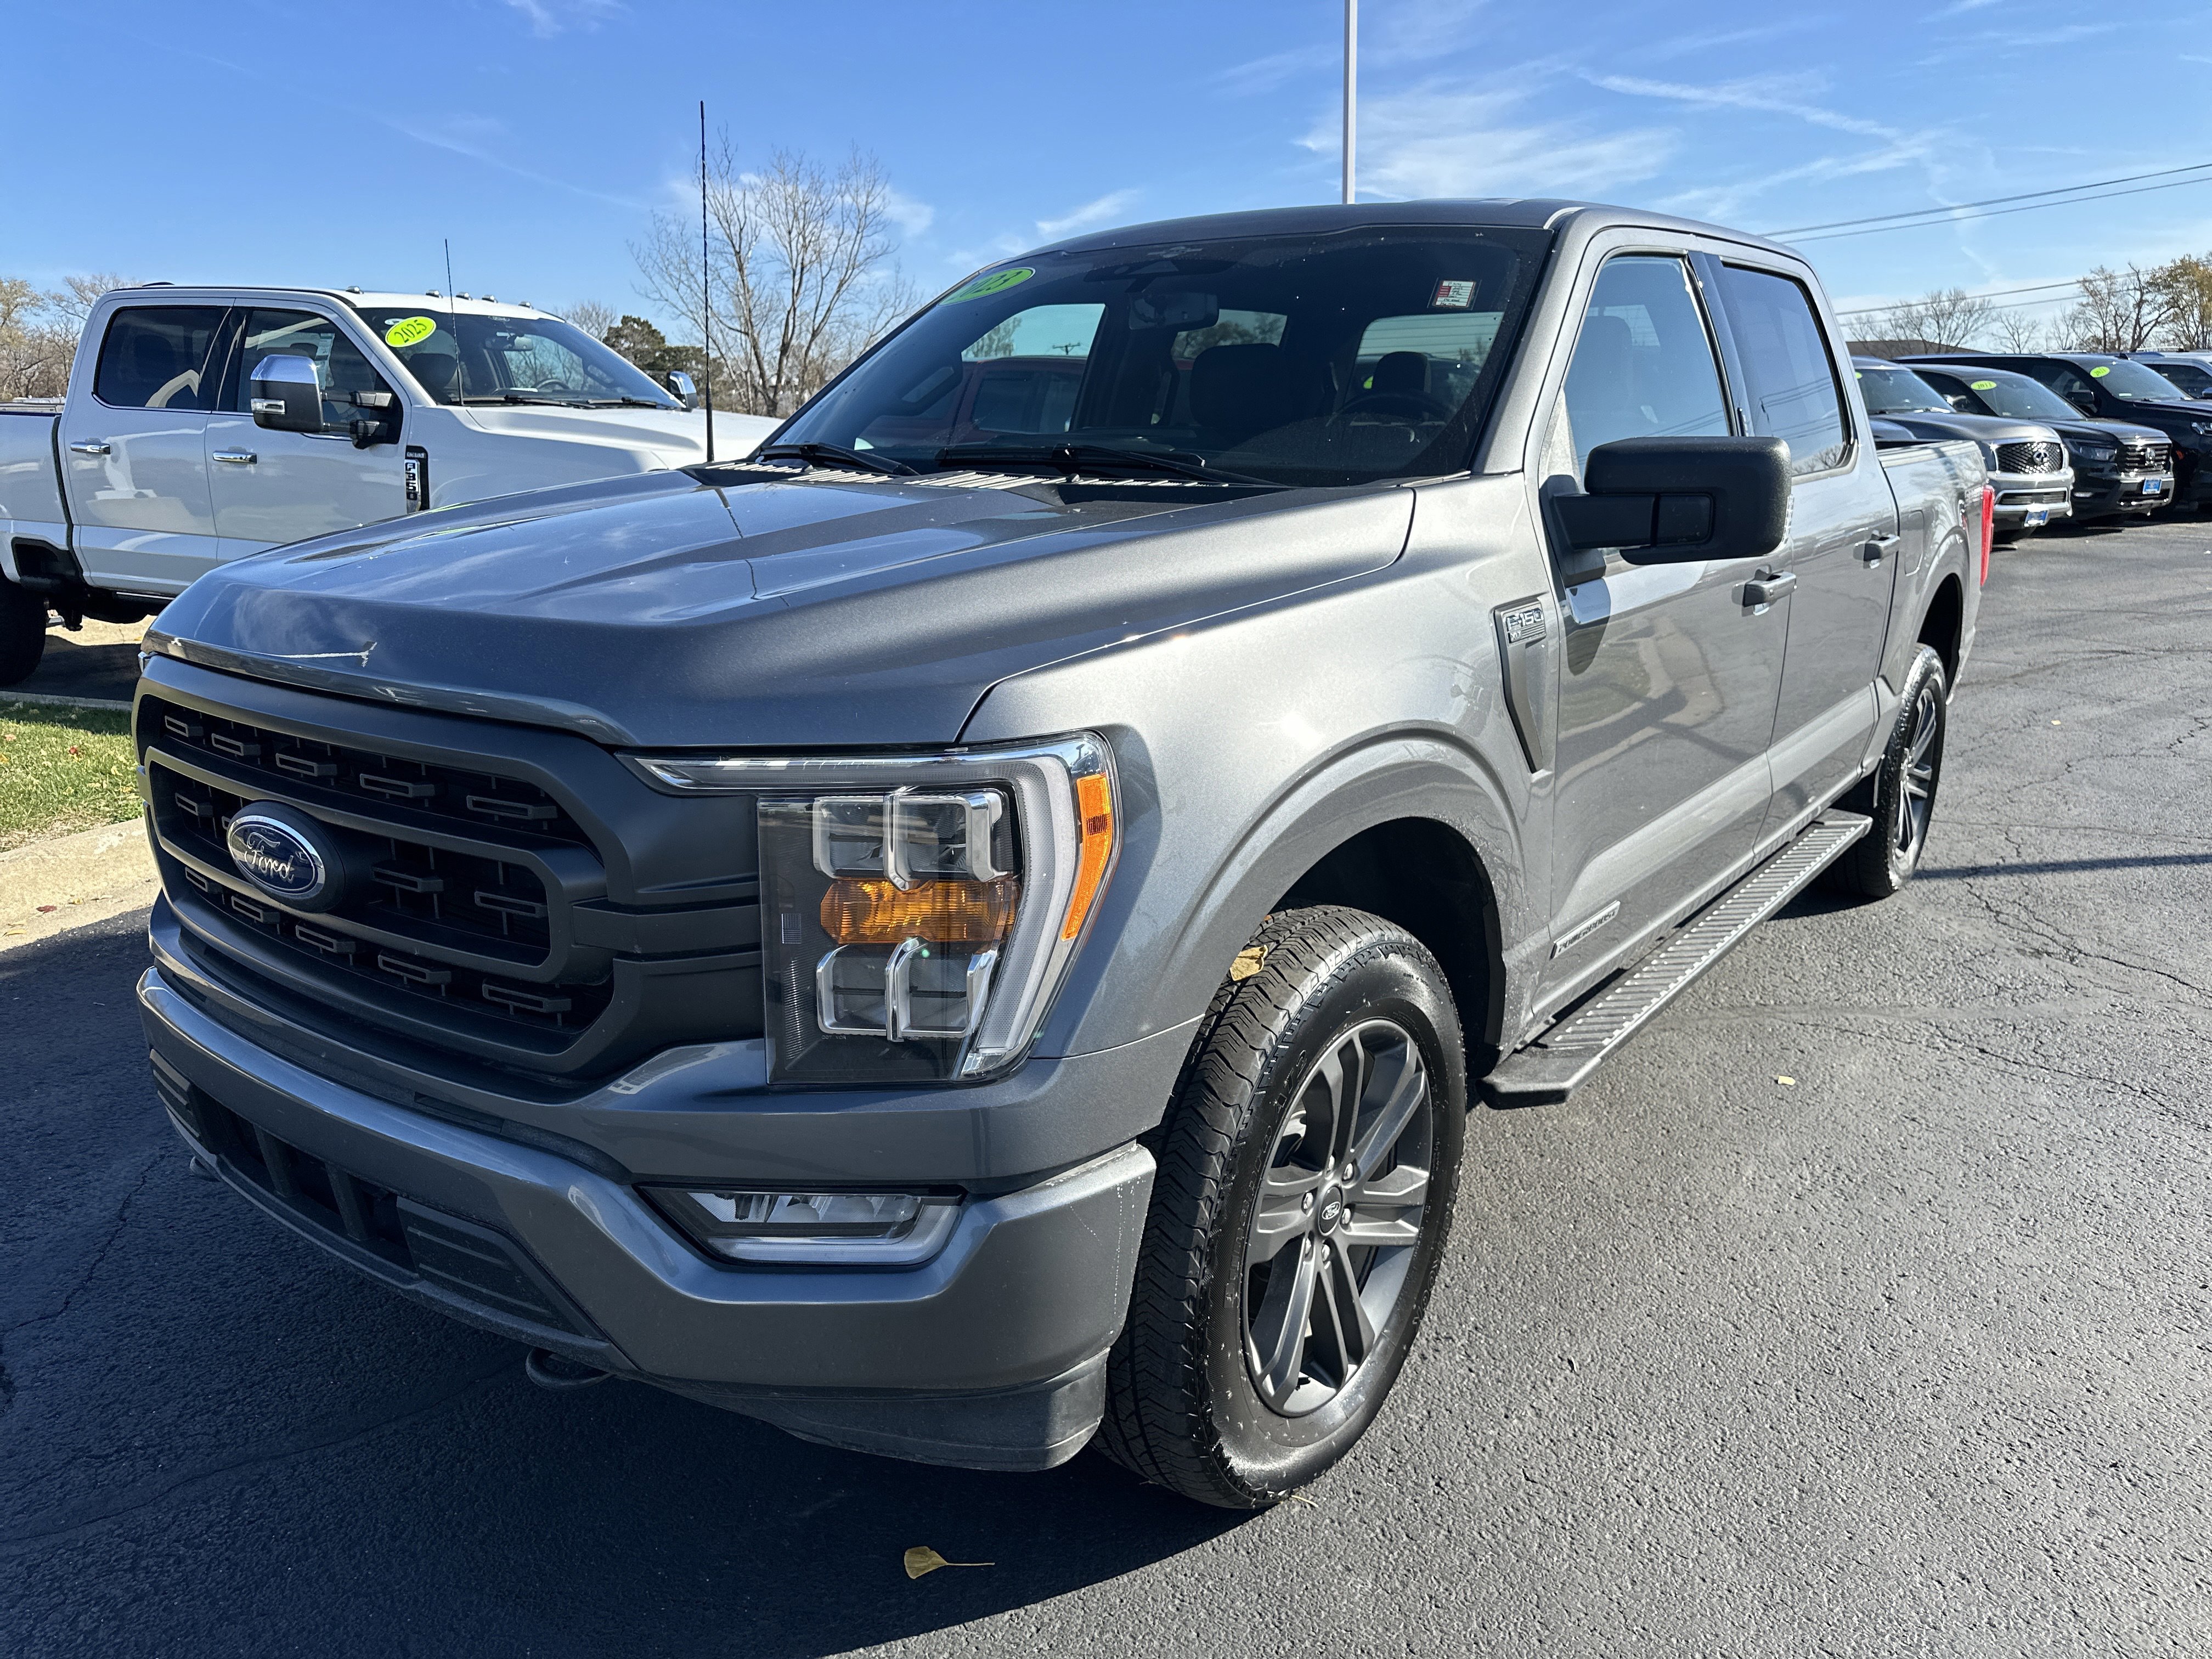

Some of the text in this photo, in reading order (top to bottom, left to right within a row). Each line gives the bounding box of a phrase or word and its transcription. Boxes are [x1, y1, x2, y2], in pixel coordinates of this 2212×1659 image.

[394, 319, 427, 343] 2025
[1505, 608, 1544, 631] F-150
[244, 832, 295, 884] Ford
